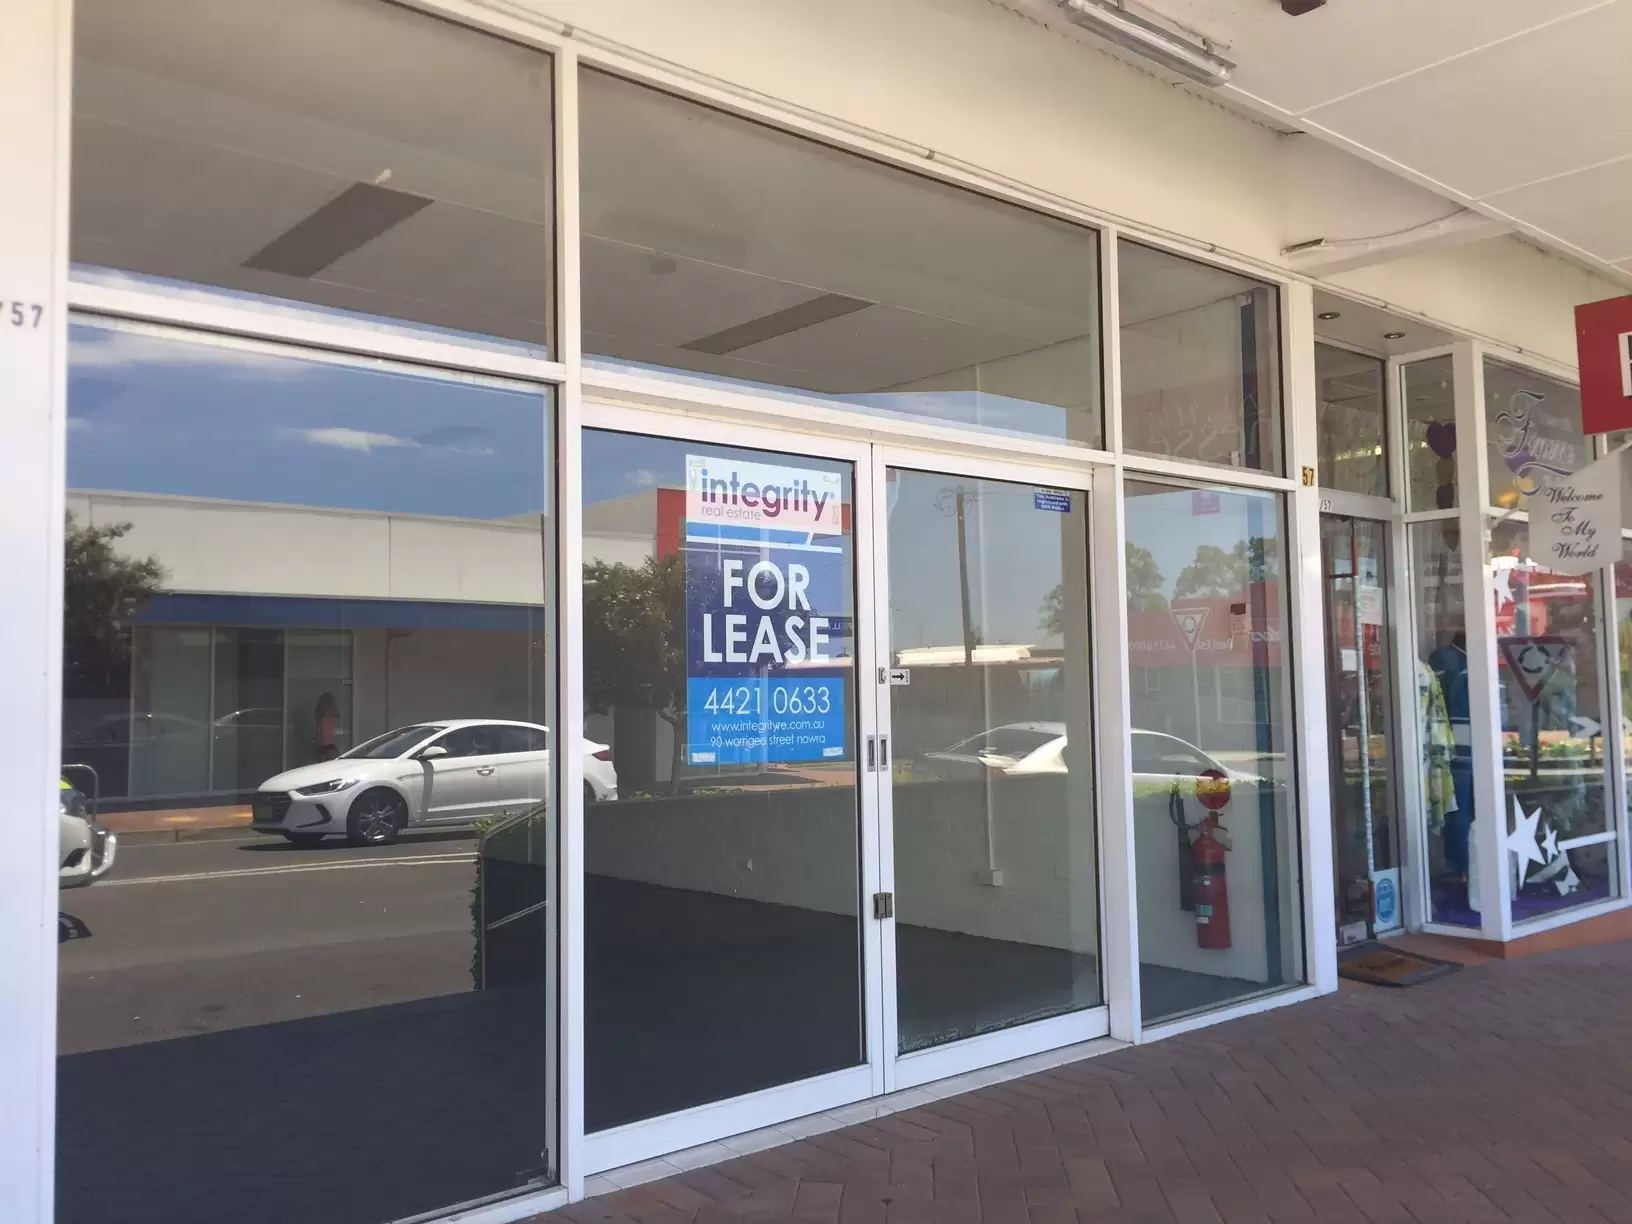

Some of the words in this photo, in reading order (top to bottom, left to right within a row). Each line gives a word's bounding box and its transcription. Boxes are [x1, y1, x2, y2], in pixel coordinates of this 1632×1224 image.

[1302, 466, 1315, 487] 57
[701, 468, 829, 521] integrity
[1544, 486, 1603, 503] Welcome
[701, 506, 724, 517] real
[727, 507, 762, 521] estate
[1551, 507, 1578, 524] To
[1561, 519, 1597, 542] My
[1552, 542, 1600, 559] World
[723, 559, 811, 611] FOR
[703, 613, 830, 664] LEASE
[703, 686, 761, 715] 4421
[773, 686, 831, 715] 0633
[711, 720, 826, 734] www.integrityre.com.au
[710, 736, 723, 748] 90
[726, 736, 767, 749] worrigee
[769, 734, 794, 746] street
[796, 734, 826, 745] nowra
